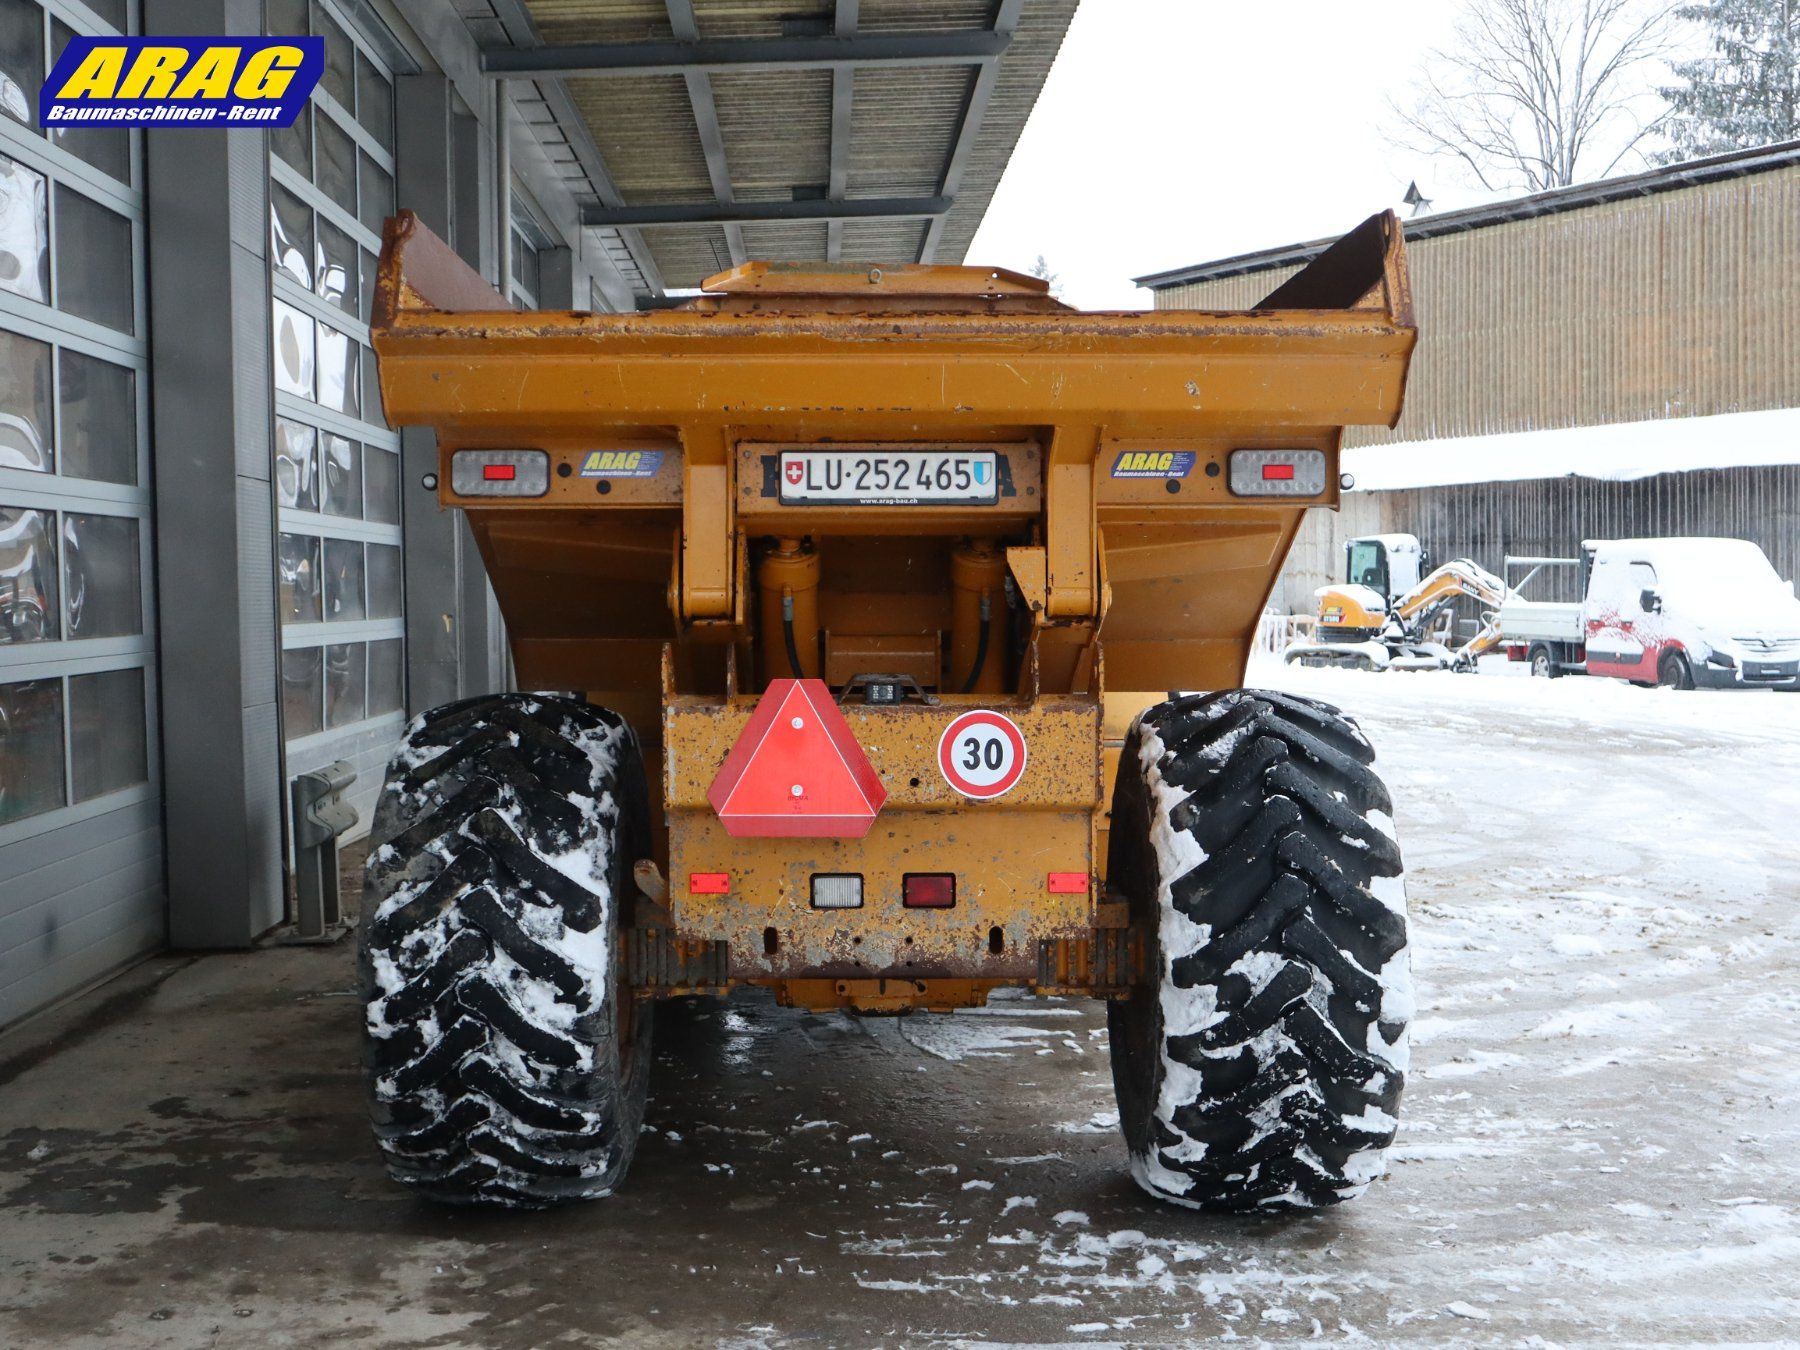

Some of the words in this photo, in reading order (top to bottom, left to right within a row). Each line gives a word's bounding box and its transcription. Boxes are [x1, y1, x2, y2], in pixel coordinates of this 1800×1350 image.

[584, 452, 641, 469] ARAG
[1116, 452, 1174, 471] ARAG
[962, 737, 1004, 771] 30
